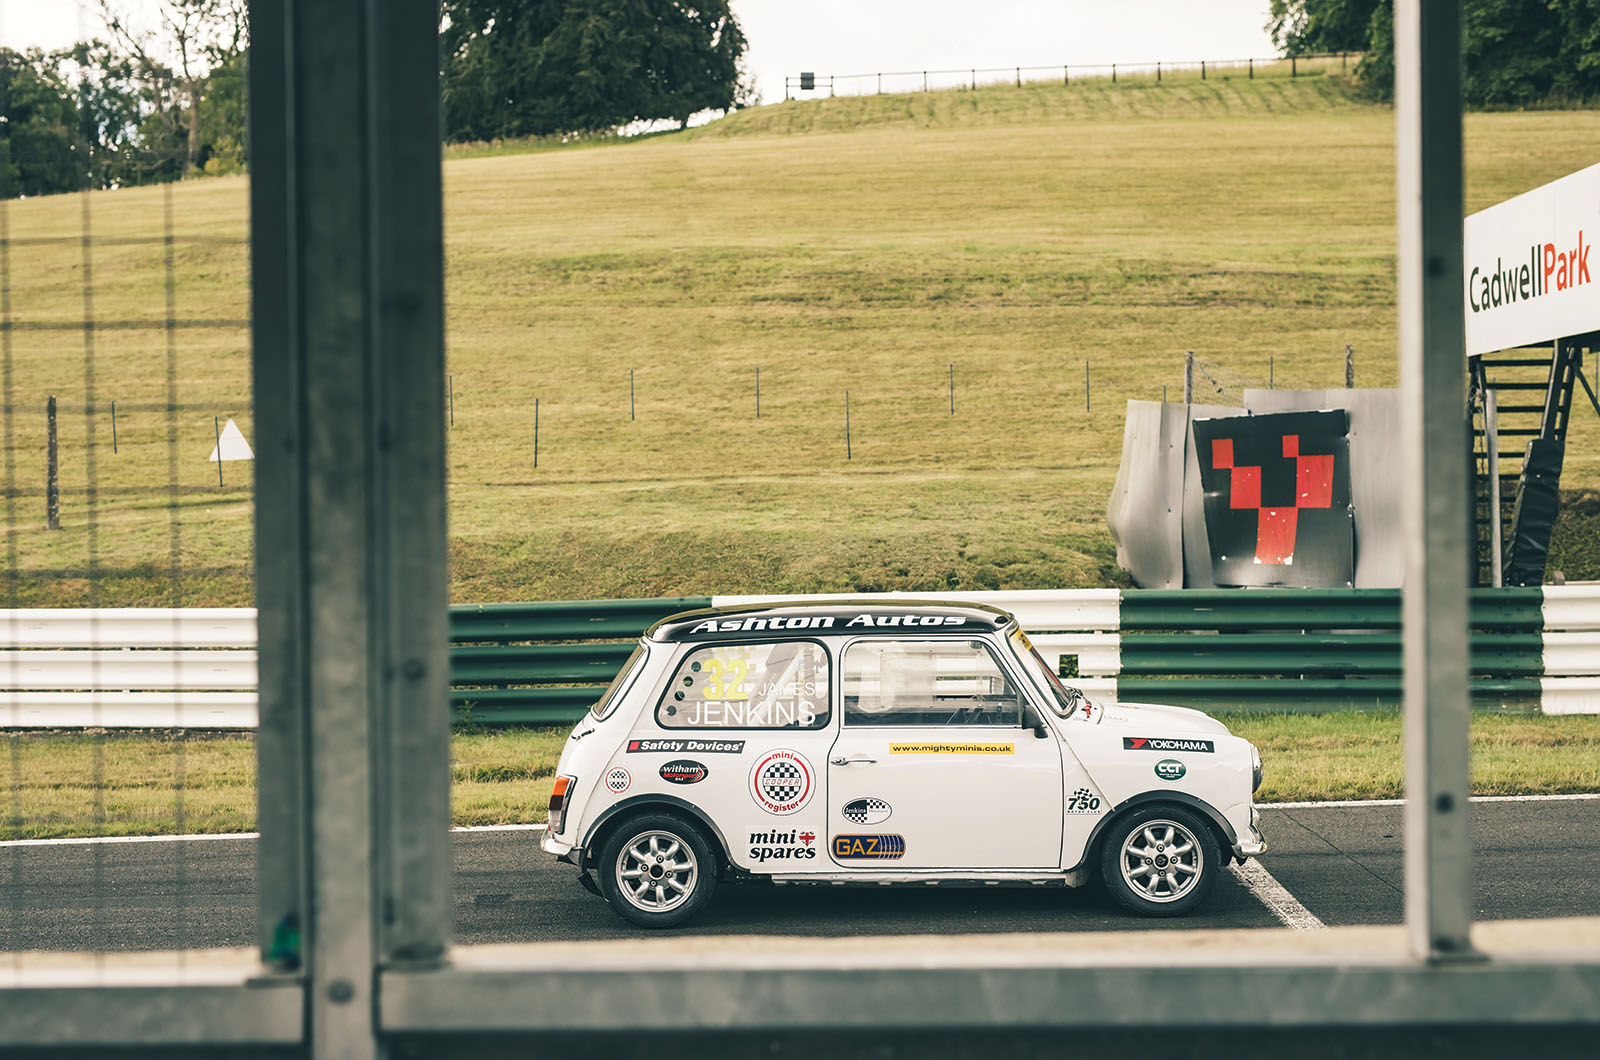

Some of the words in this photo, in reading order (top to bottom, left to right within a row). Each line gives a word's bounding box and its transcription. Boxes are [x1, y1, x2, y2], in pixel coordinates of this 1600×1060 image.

[1469, 230, 1591, 313] CadwellPark
[690, 615, 835, 635] Ashton
[846, 613, 967, 629] Autos
[702, 658, 748, 701] 32
[758, 682, 815, 696] JAMES
[687, 701, 816, 725] JENKINS
[640, 740, 684, 751] Safety
[686, 741, 740, 751] Devices
[893, 744, 1012, 753] www.mightyminis.co.uk
[1148, 739, 1208, 751] YOKOHAMA
[771, 751, 794, 760] mini
[663, 764, 699, 773] witham
[1158, 763, 1182, 773] CCT
[765, 778, 800, 786] COOPER
[764, 800, 800, 813] register
[1067, 796, 1100, 810] 750
[749, 829, 797, 845] mini
[836, 839, 879, 855] GAZ
[749, 847, 816, 863] spares
